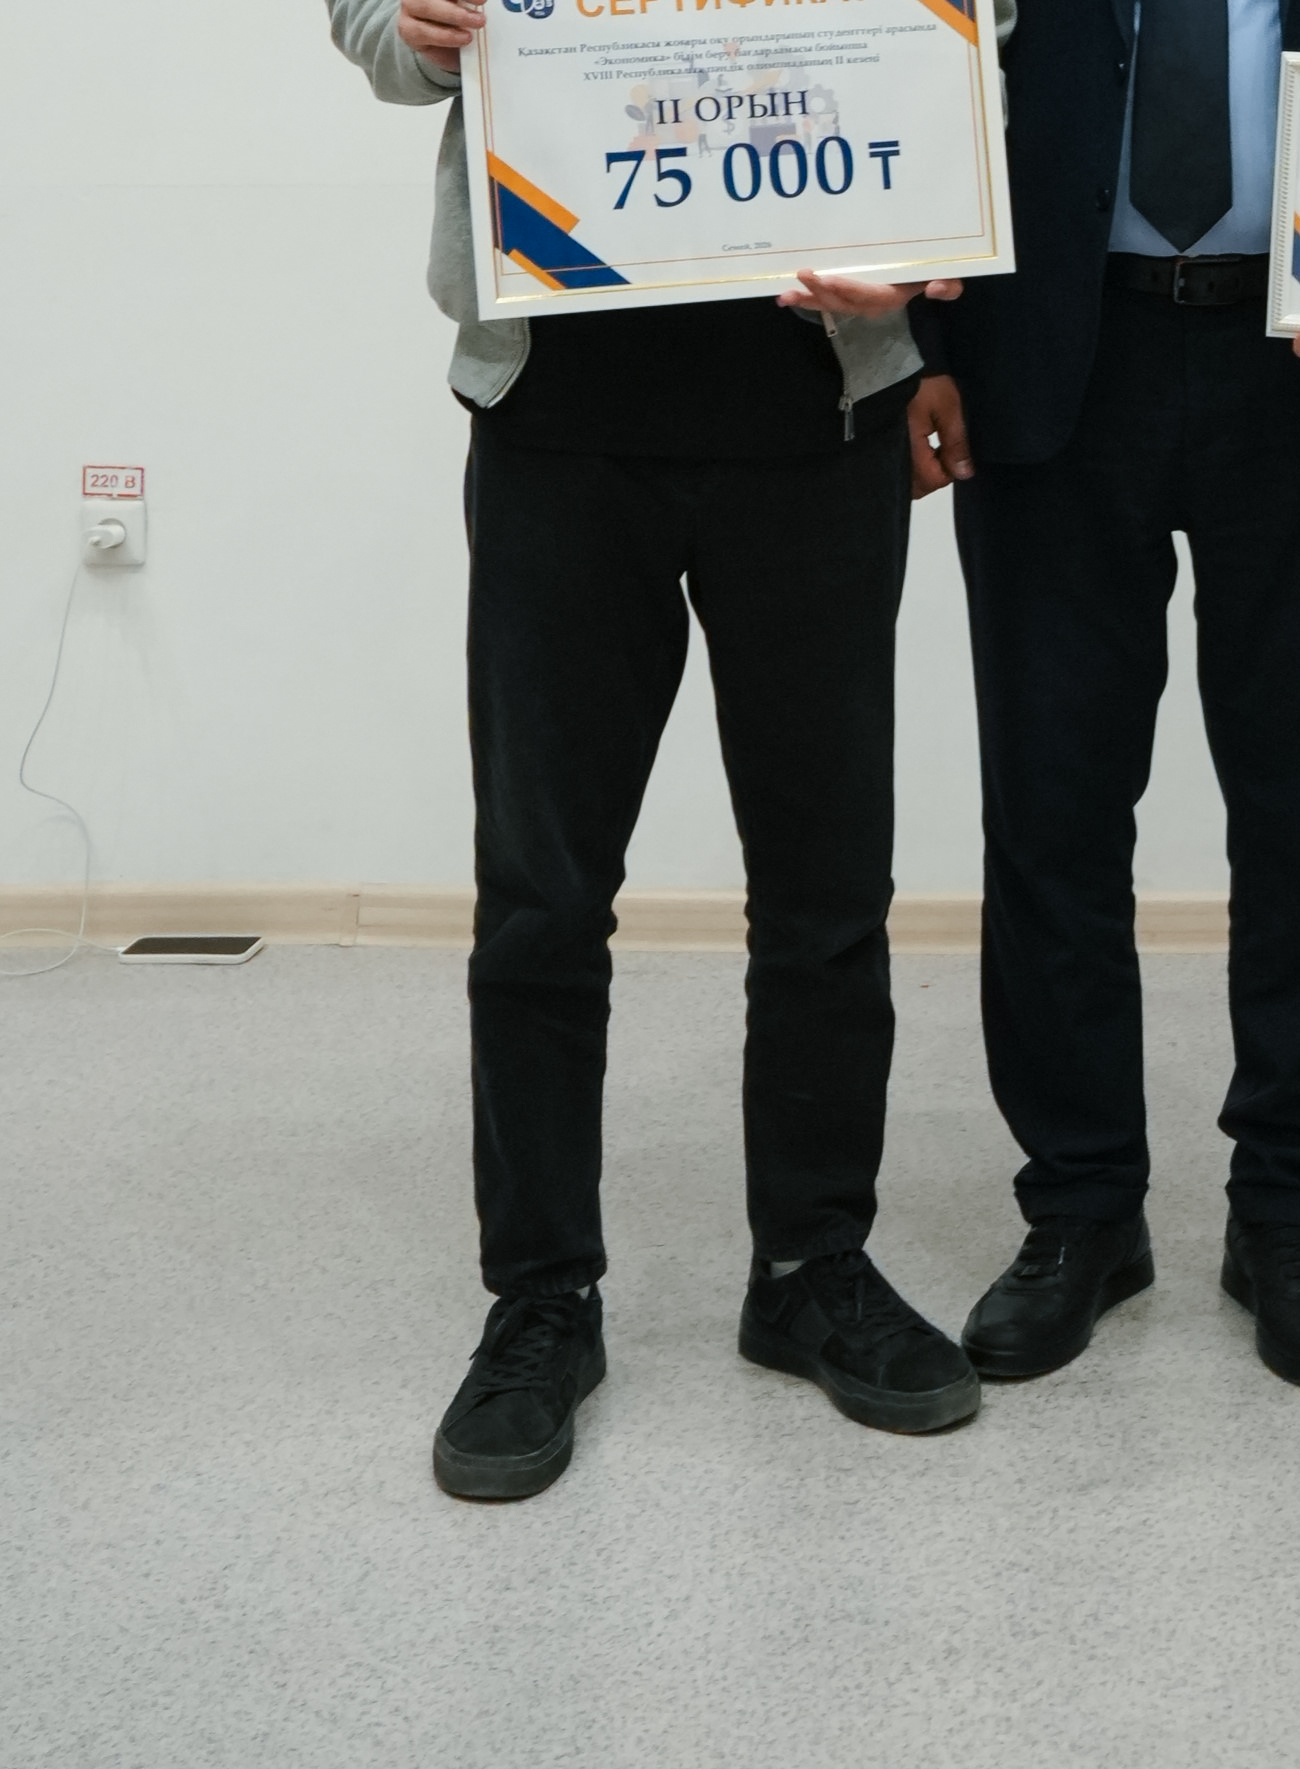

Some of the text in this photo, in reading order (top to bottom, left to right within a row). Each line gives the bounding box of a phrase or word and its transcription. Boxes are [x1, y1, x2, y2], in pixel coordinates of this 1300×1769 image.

[695, 90, 808, 122] ОРЫН
[605, 146, 693, 211] 75
[722, 135, 856, 203] 000
[90, 474, 119, 488] 220
